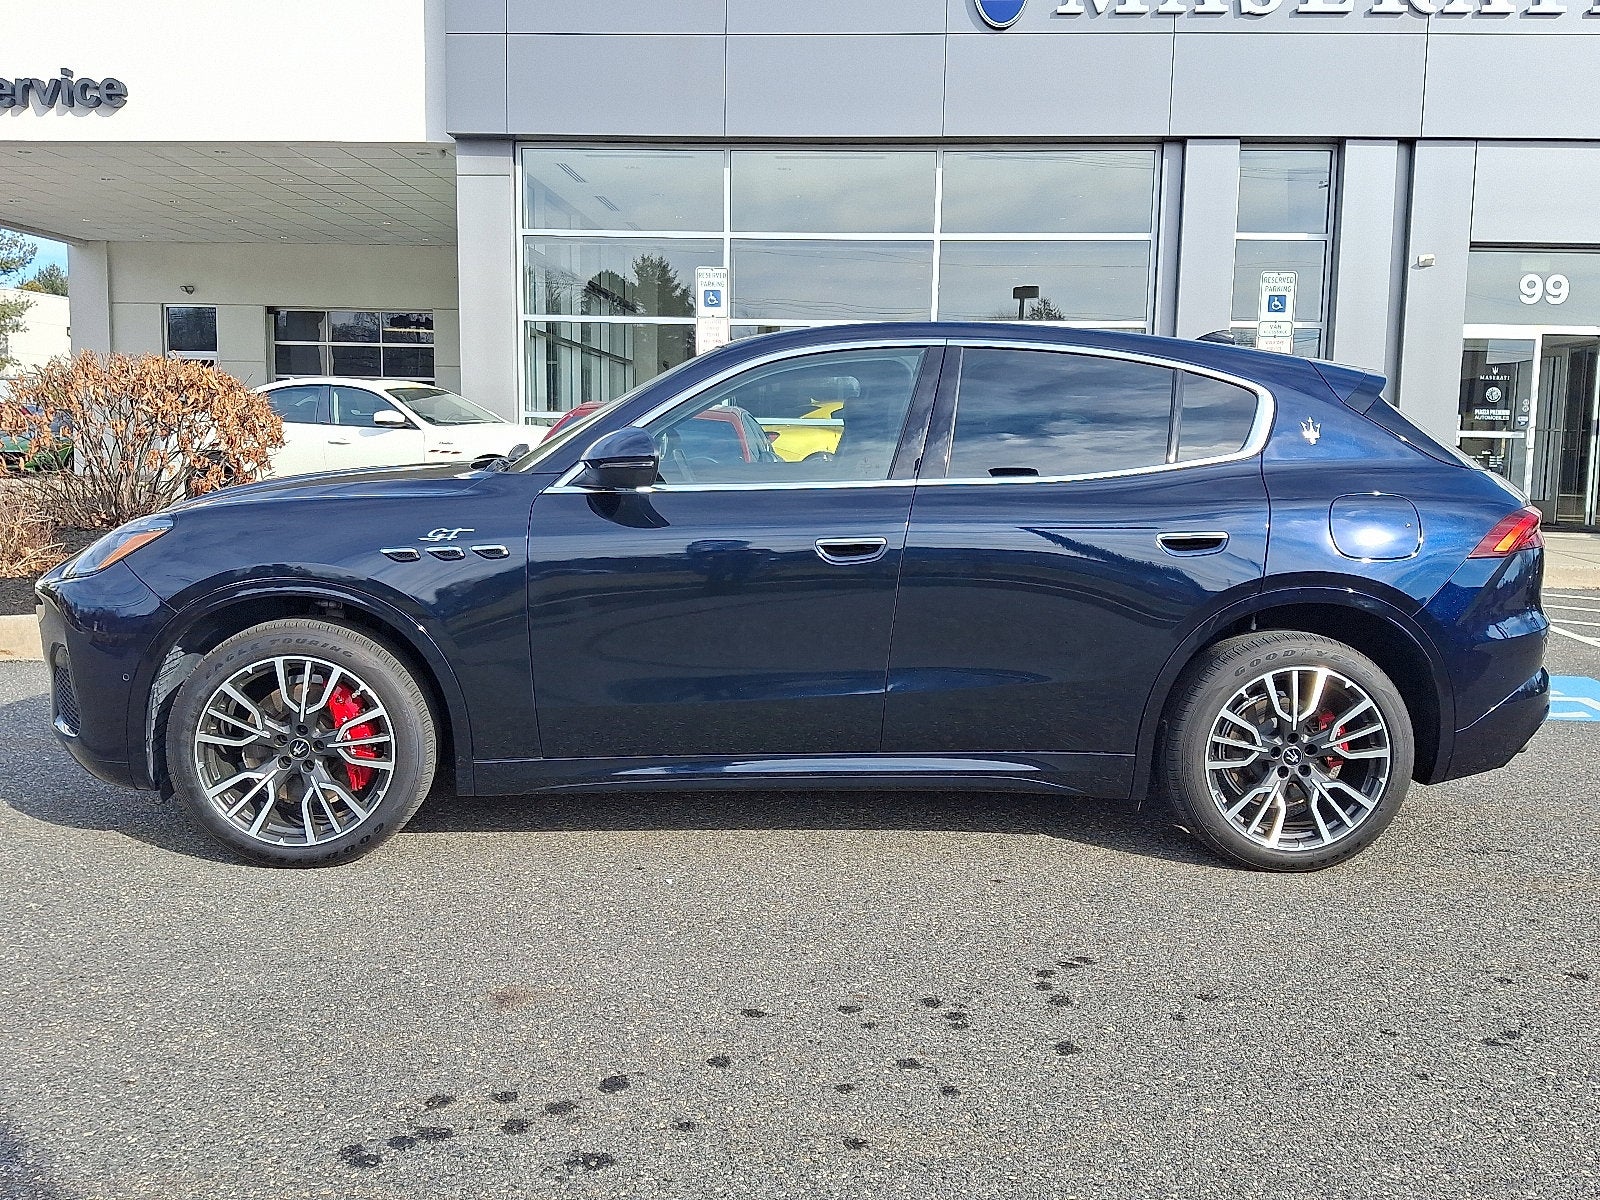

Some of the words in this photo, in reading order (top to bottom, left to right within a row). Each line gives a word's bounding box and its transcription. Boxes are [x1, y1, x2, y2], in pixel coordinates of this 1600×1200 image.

[1263, 276, 1295, 284] RESERVED
[1264, 285, 1292, 293] PARKING
[1519, 273, 1570, 305] 99
[269, 637, 355, 658] TOURING
